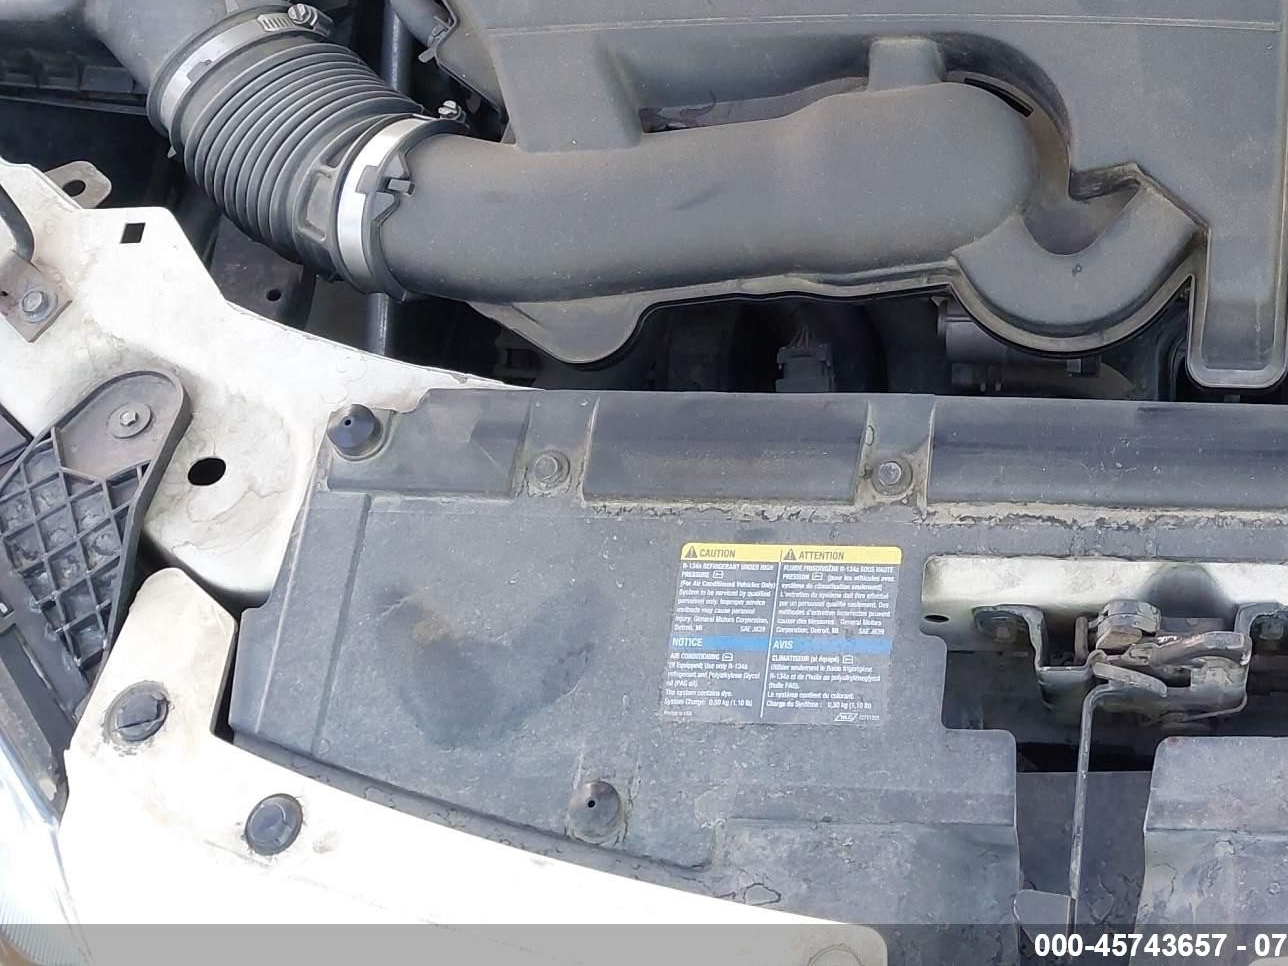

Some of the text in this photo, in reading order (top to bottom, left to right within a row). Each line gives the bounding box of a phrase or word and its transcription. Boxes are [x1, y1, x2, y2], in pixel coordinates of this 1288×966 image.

[699, 548, 736, 558] CAUTION
[799, 551, 845, 561] ATTENTION
[672, 637, 704, 647] NOTICE
[773, 640, 794, 650] AVIS
